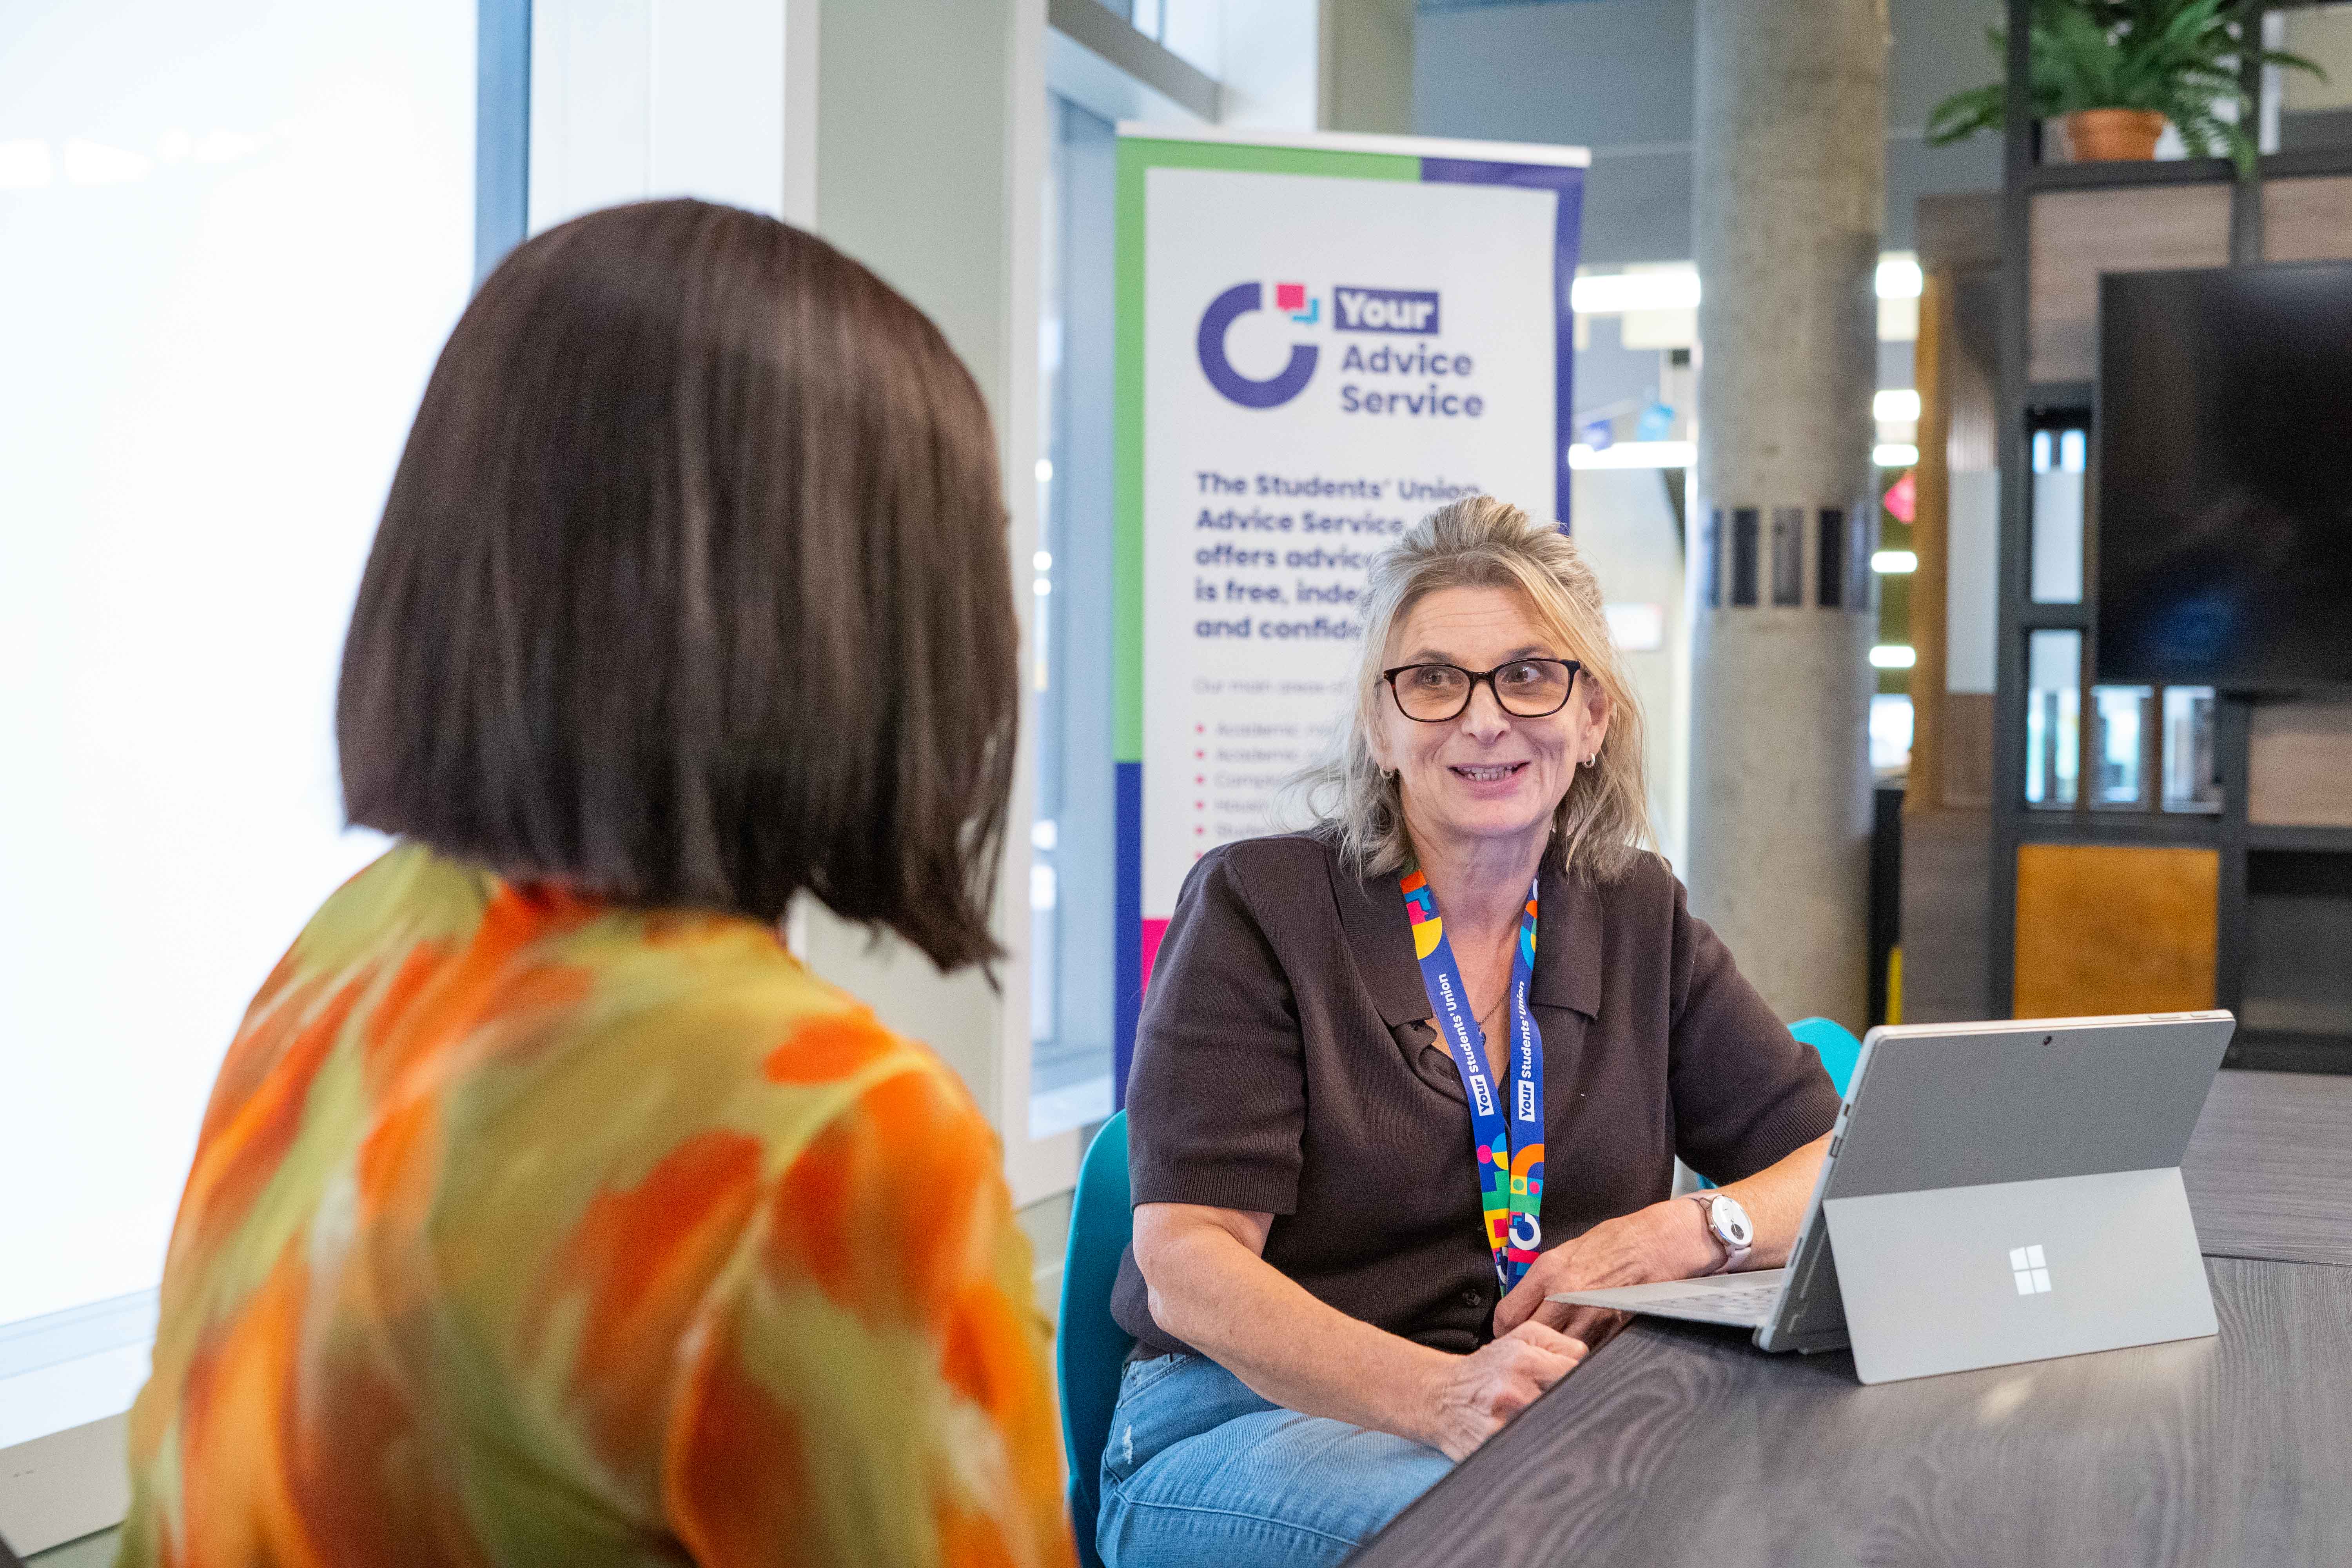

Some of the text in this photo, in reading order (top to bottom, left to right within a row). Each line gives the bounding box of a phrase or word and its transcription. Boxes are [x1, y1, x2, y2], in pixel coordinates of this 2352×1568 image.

[1339, 292, 1434, 328] Your
[1341, 343, 1473, 376] Advice
[1340, 382, 1484, 417] Service
[1196, 471, 1247, 495] The
[1255, 473, 1390, 499] Students'
[1196, 510, 1405, 534] Advice Service
[1196, 543, 1276, 566] offers
[1196, 577, 1359, 604] is free, inde
[1195, 615, 1252, 638] and
[1438, 973, 1490, 1113] Your Students' Union
[1516, 981, 1532, 1117] Your Students' Union
